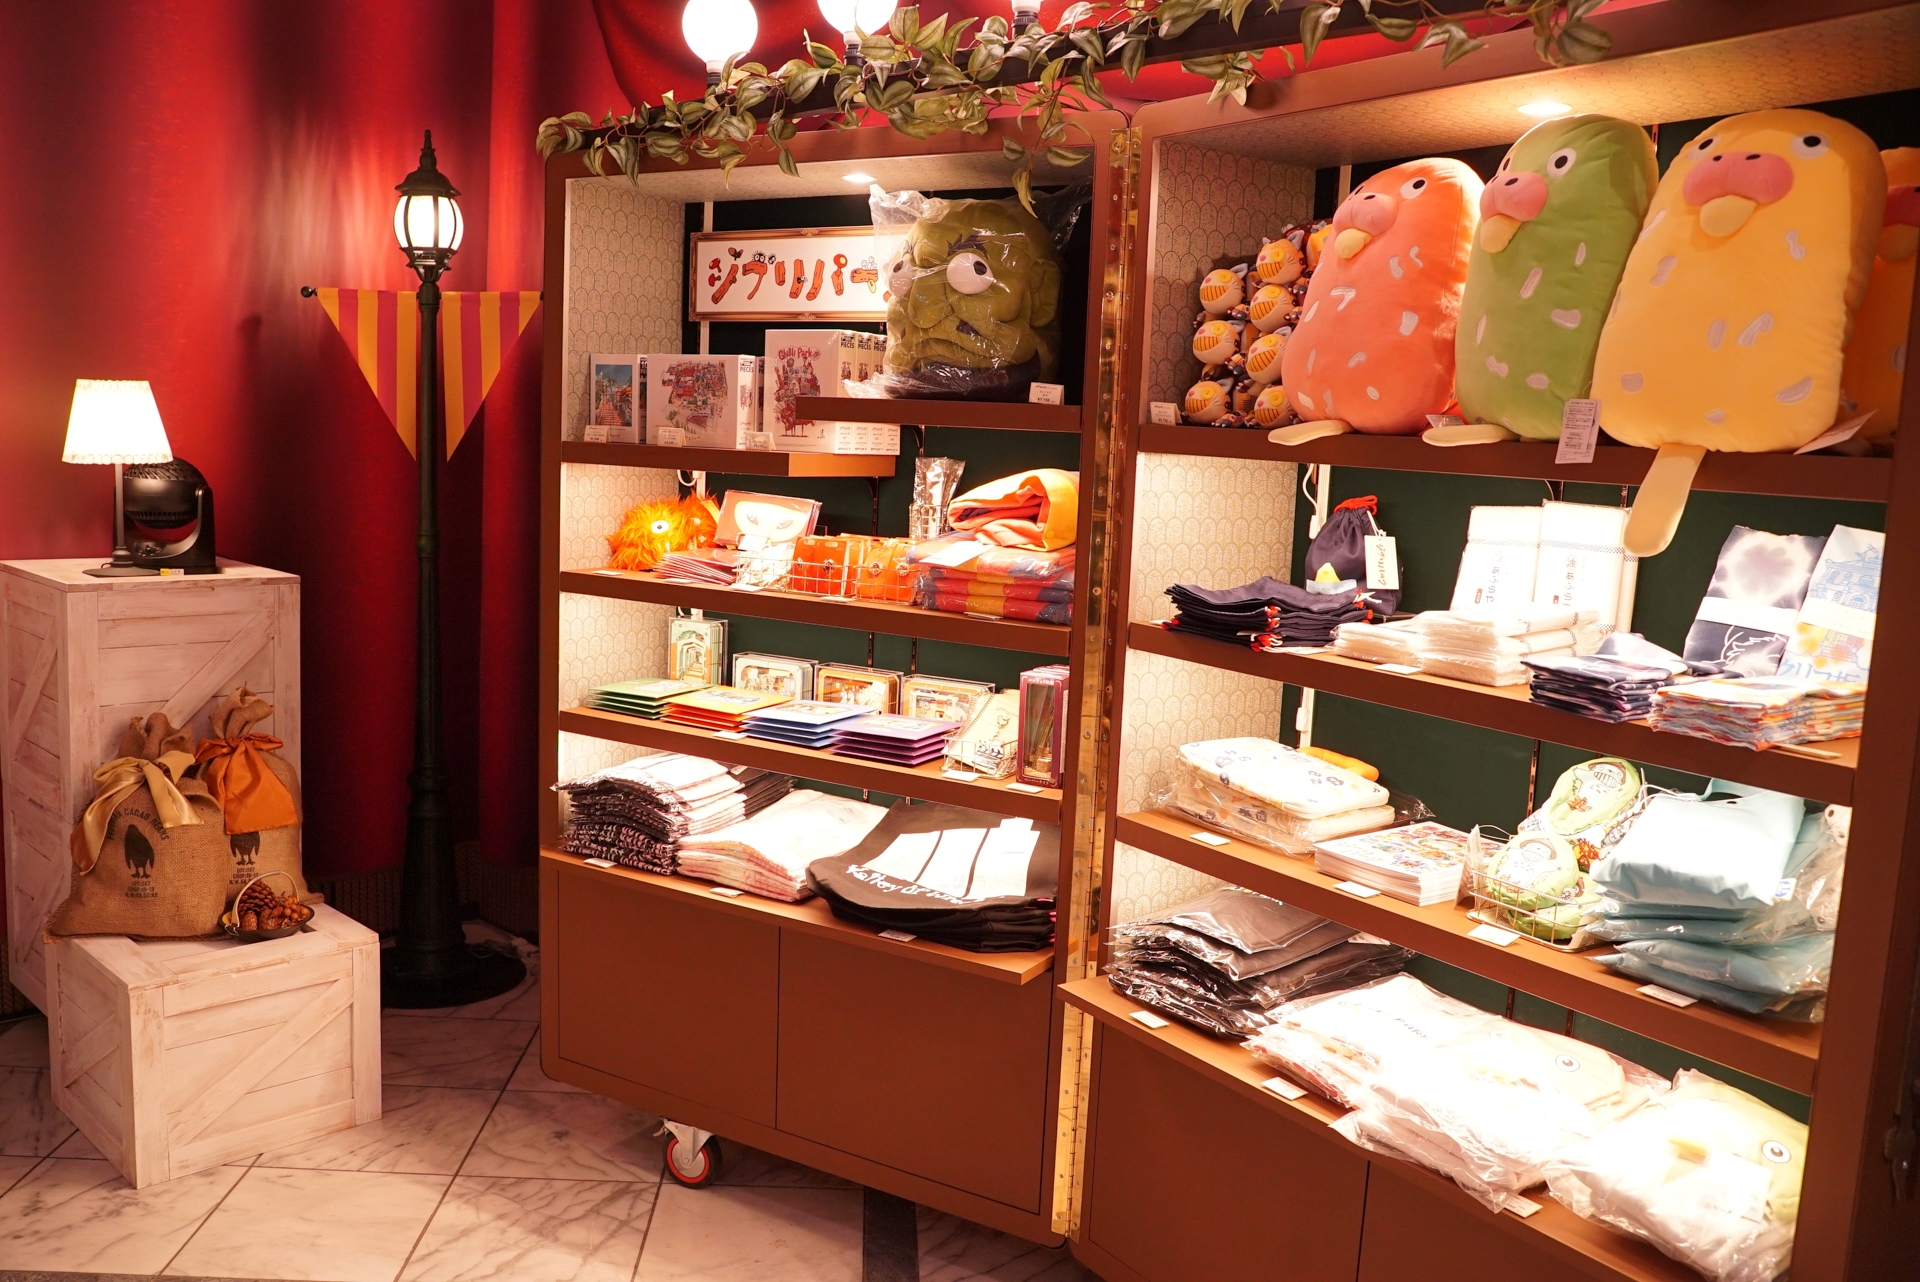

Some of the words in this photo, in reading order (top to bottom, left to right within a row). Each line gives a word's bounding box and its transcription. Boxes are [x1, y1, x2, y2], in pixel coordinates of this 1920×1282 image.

[708, 247, 892, 304] ジブリパー
[840, 341, 855, 349] PIECES
[797, 347, 813, 358] Park
[123, 807, 151, 821] CACAO
